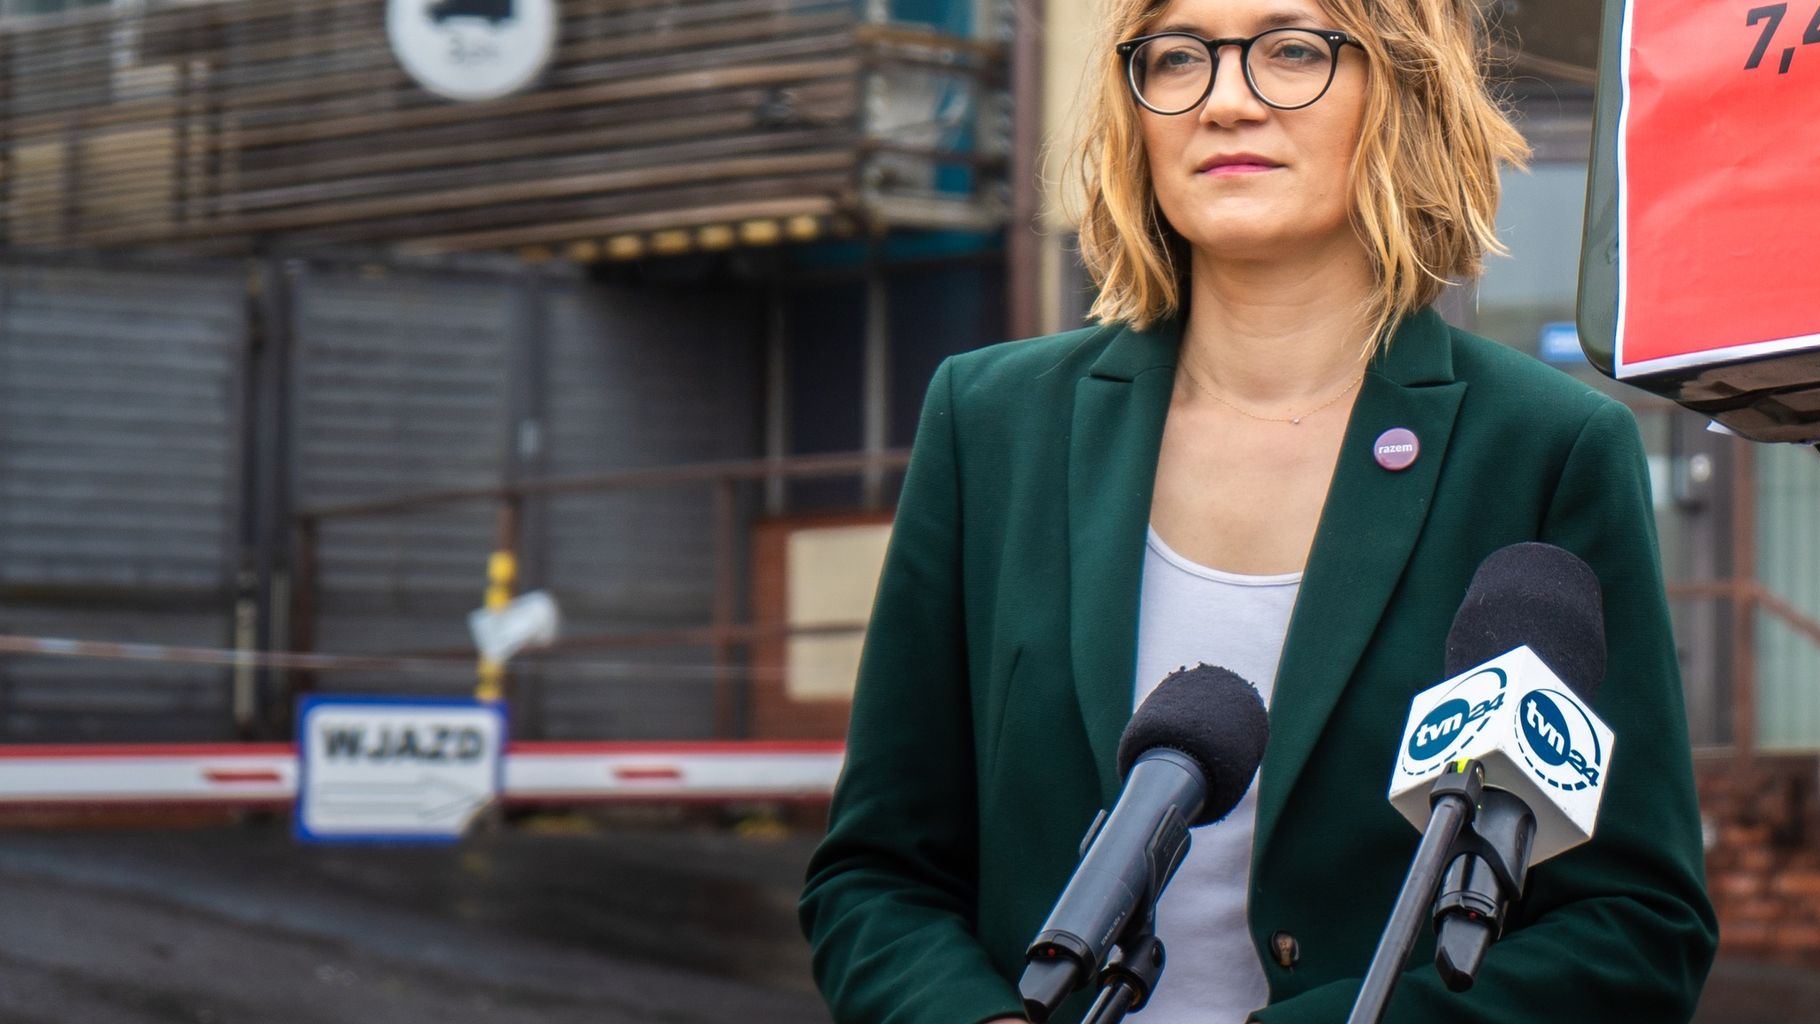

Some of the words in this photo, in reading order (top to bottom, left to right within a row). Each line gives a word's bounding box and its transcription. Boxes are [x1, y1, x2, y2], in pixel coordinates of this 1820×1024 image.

[1378, 443, 1413, 454] razem
[1416, 712, 1463, 747] tvn
[1468, 693, 1504, 721] 24
[1526, 698, 1565, 756] tvn
[1566, 749, 1600, 787] 24
[323, 726, 484, 762] WJAZD
